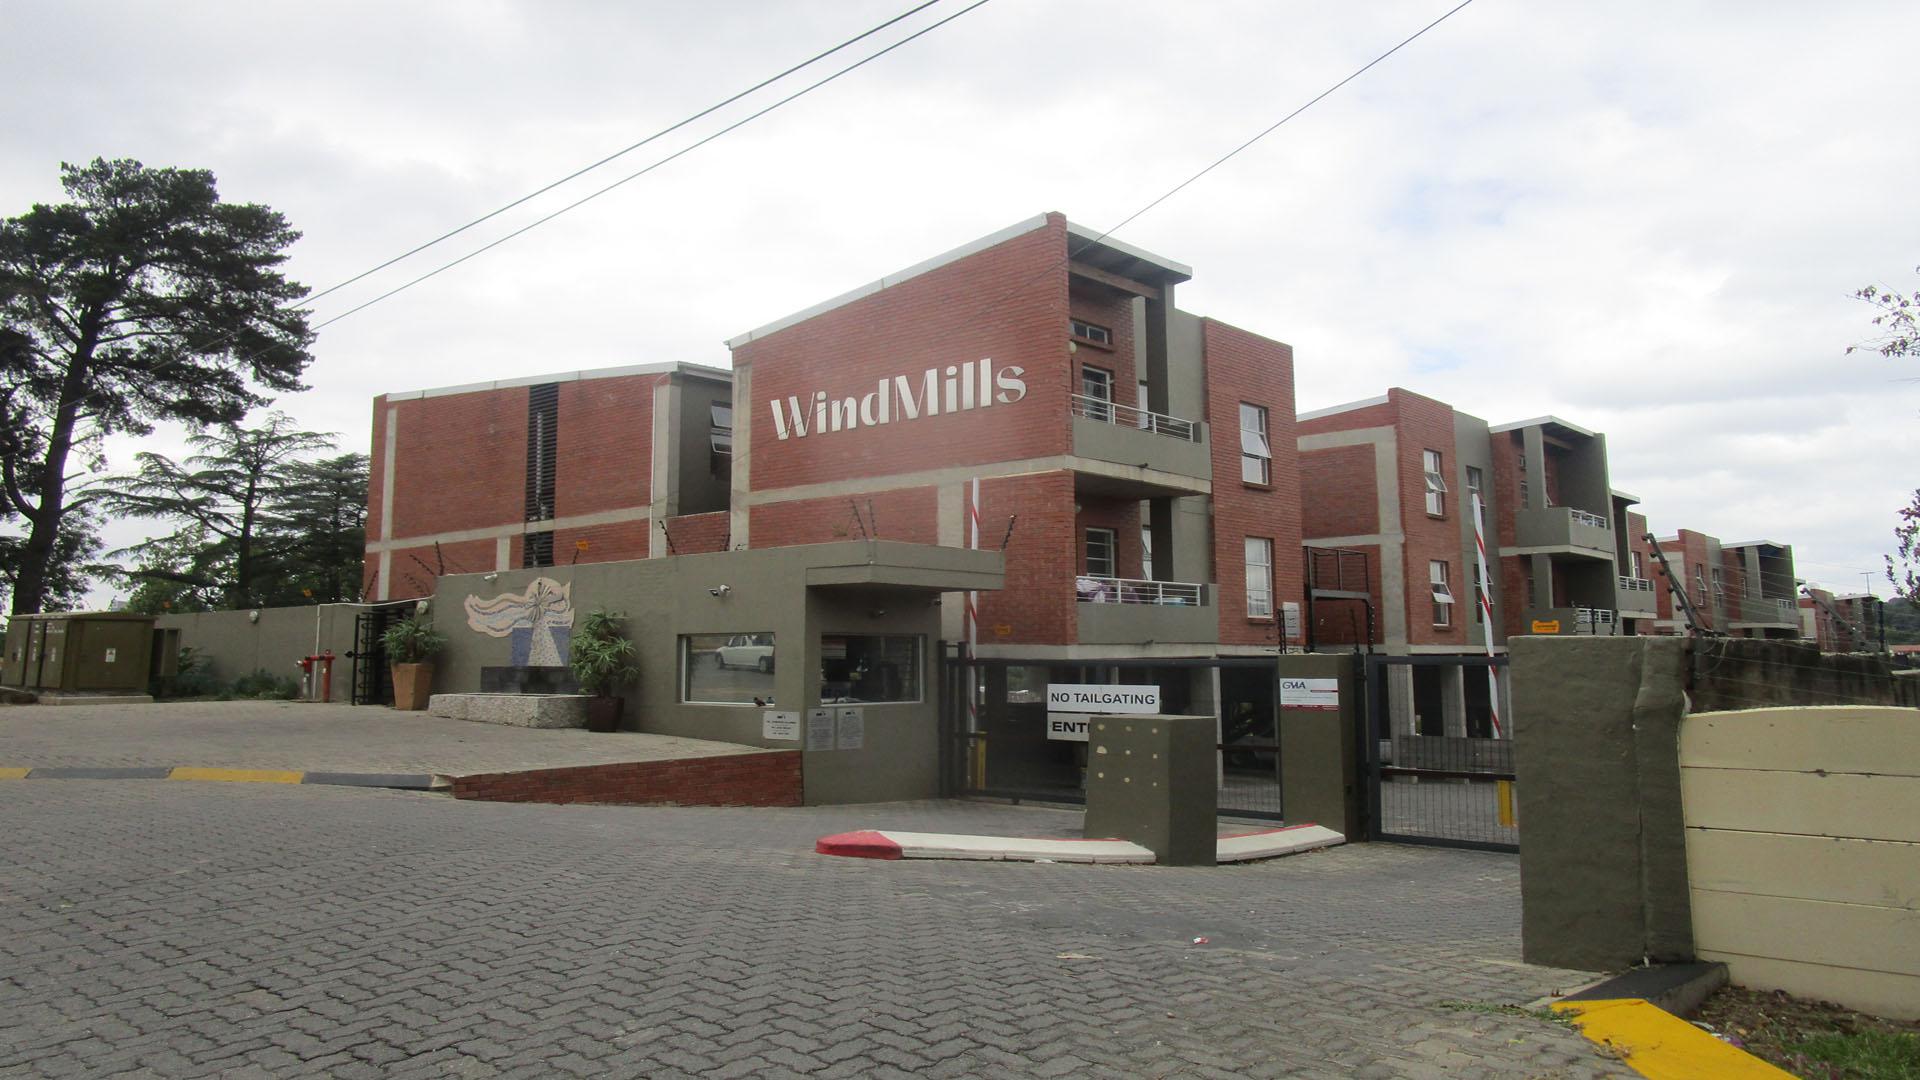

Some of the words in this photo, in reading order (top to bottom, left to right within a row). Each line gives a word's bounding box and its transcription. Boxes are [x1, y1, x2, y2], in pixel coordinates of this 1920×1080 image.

[770, 357, 1027, 441] WindMills
[1051, 692, 1070, 703] NO
[1074, 693, 1155, 705] TAILGATING
